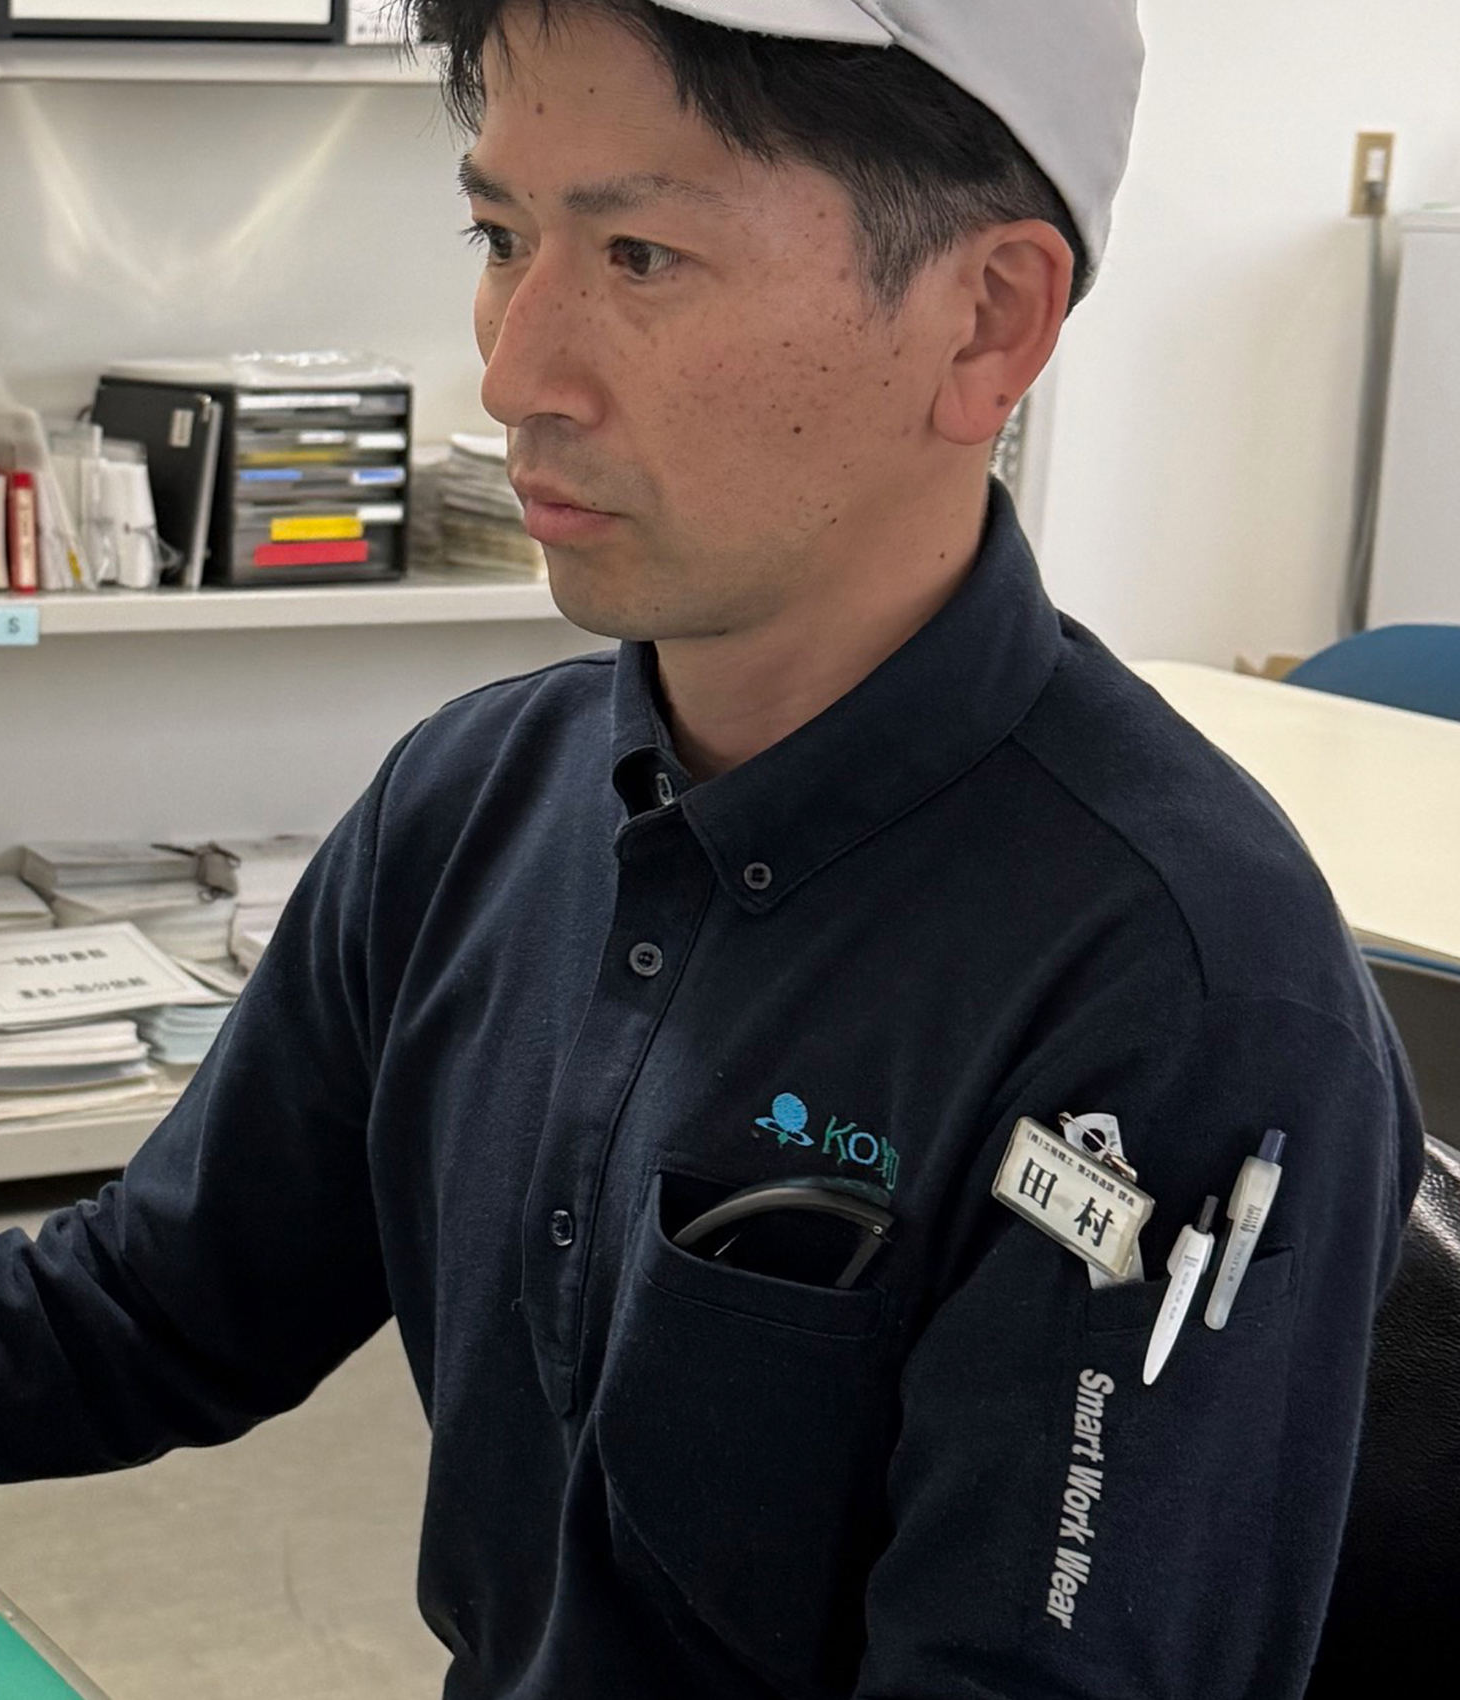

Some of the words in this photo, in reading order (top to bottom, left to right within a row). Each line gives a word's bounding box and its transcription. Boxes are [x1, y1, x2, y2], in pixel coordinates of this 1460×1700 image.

[1017, 1156, 1116, 1248] 田村
[1072, 1367, 1116, 1464] Smart
[1058, 1461, 1105, 1550] Work
[1045, 1545, 1092, 1631] Wear
